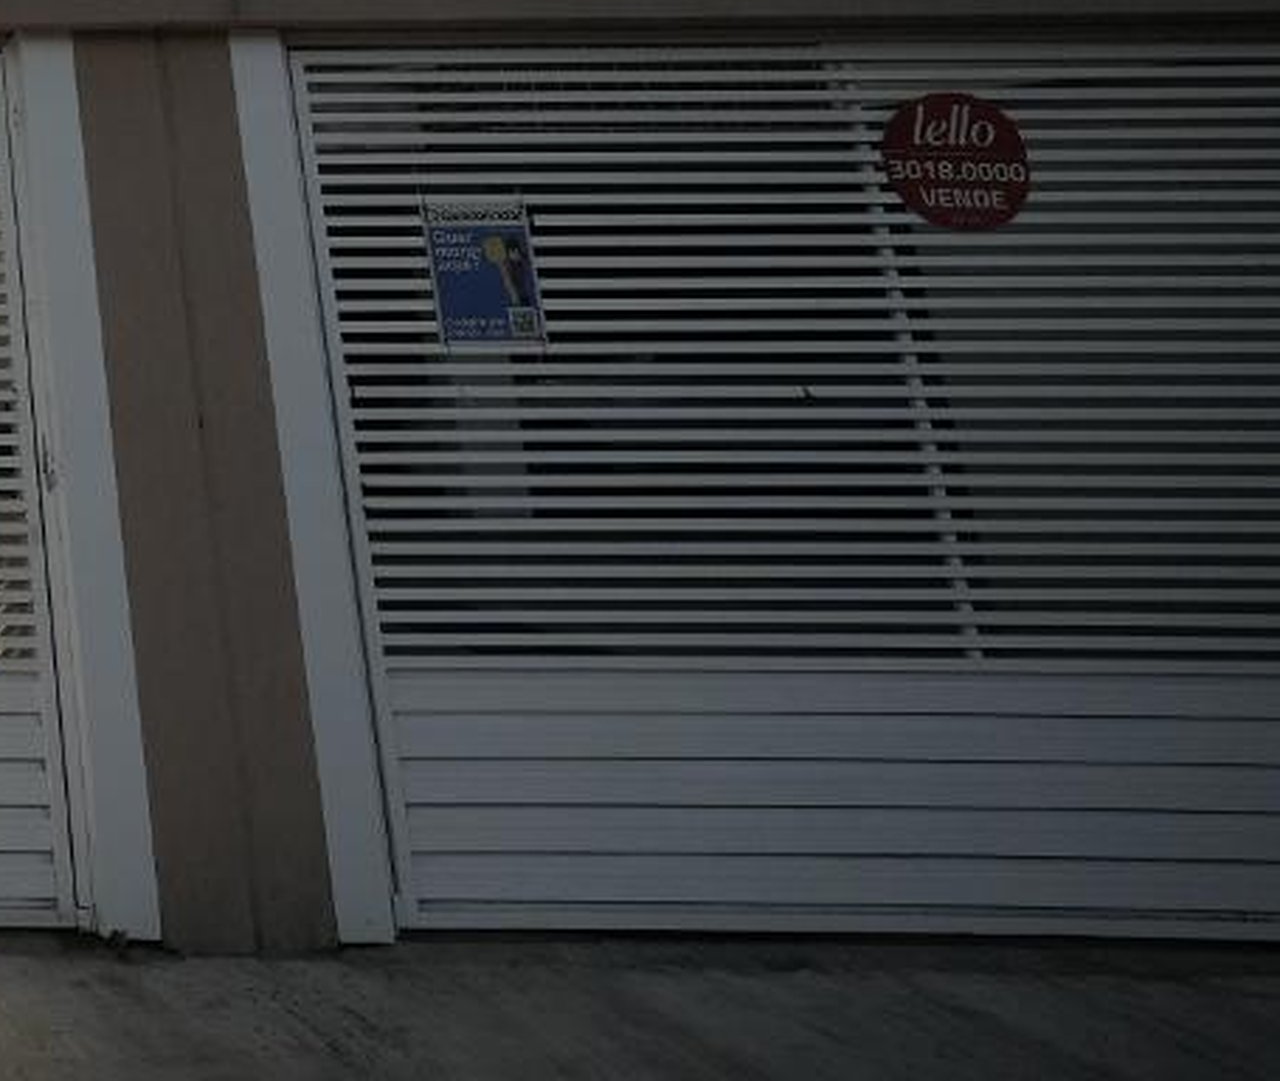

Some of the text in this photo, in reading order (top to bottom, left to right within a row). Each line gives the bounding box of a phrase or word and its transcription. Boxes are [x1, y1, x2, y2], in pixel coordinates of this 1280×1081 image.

[913, 104, 995, 147] lello
[888, 160, 1026, 183] 3018.0000
[918, 185, 1008, 210] VENDE
